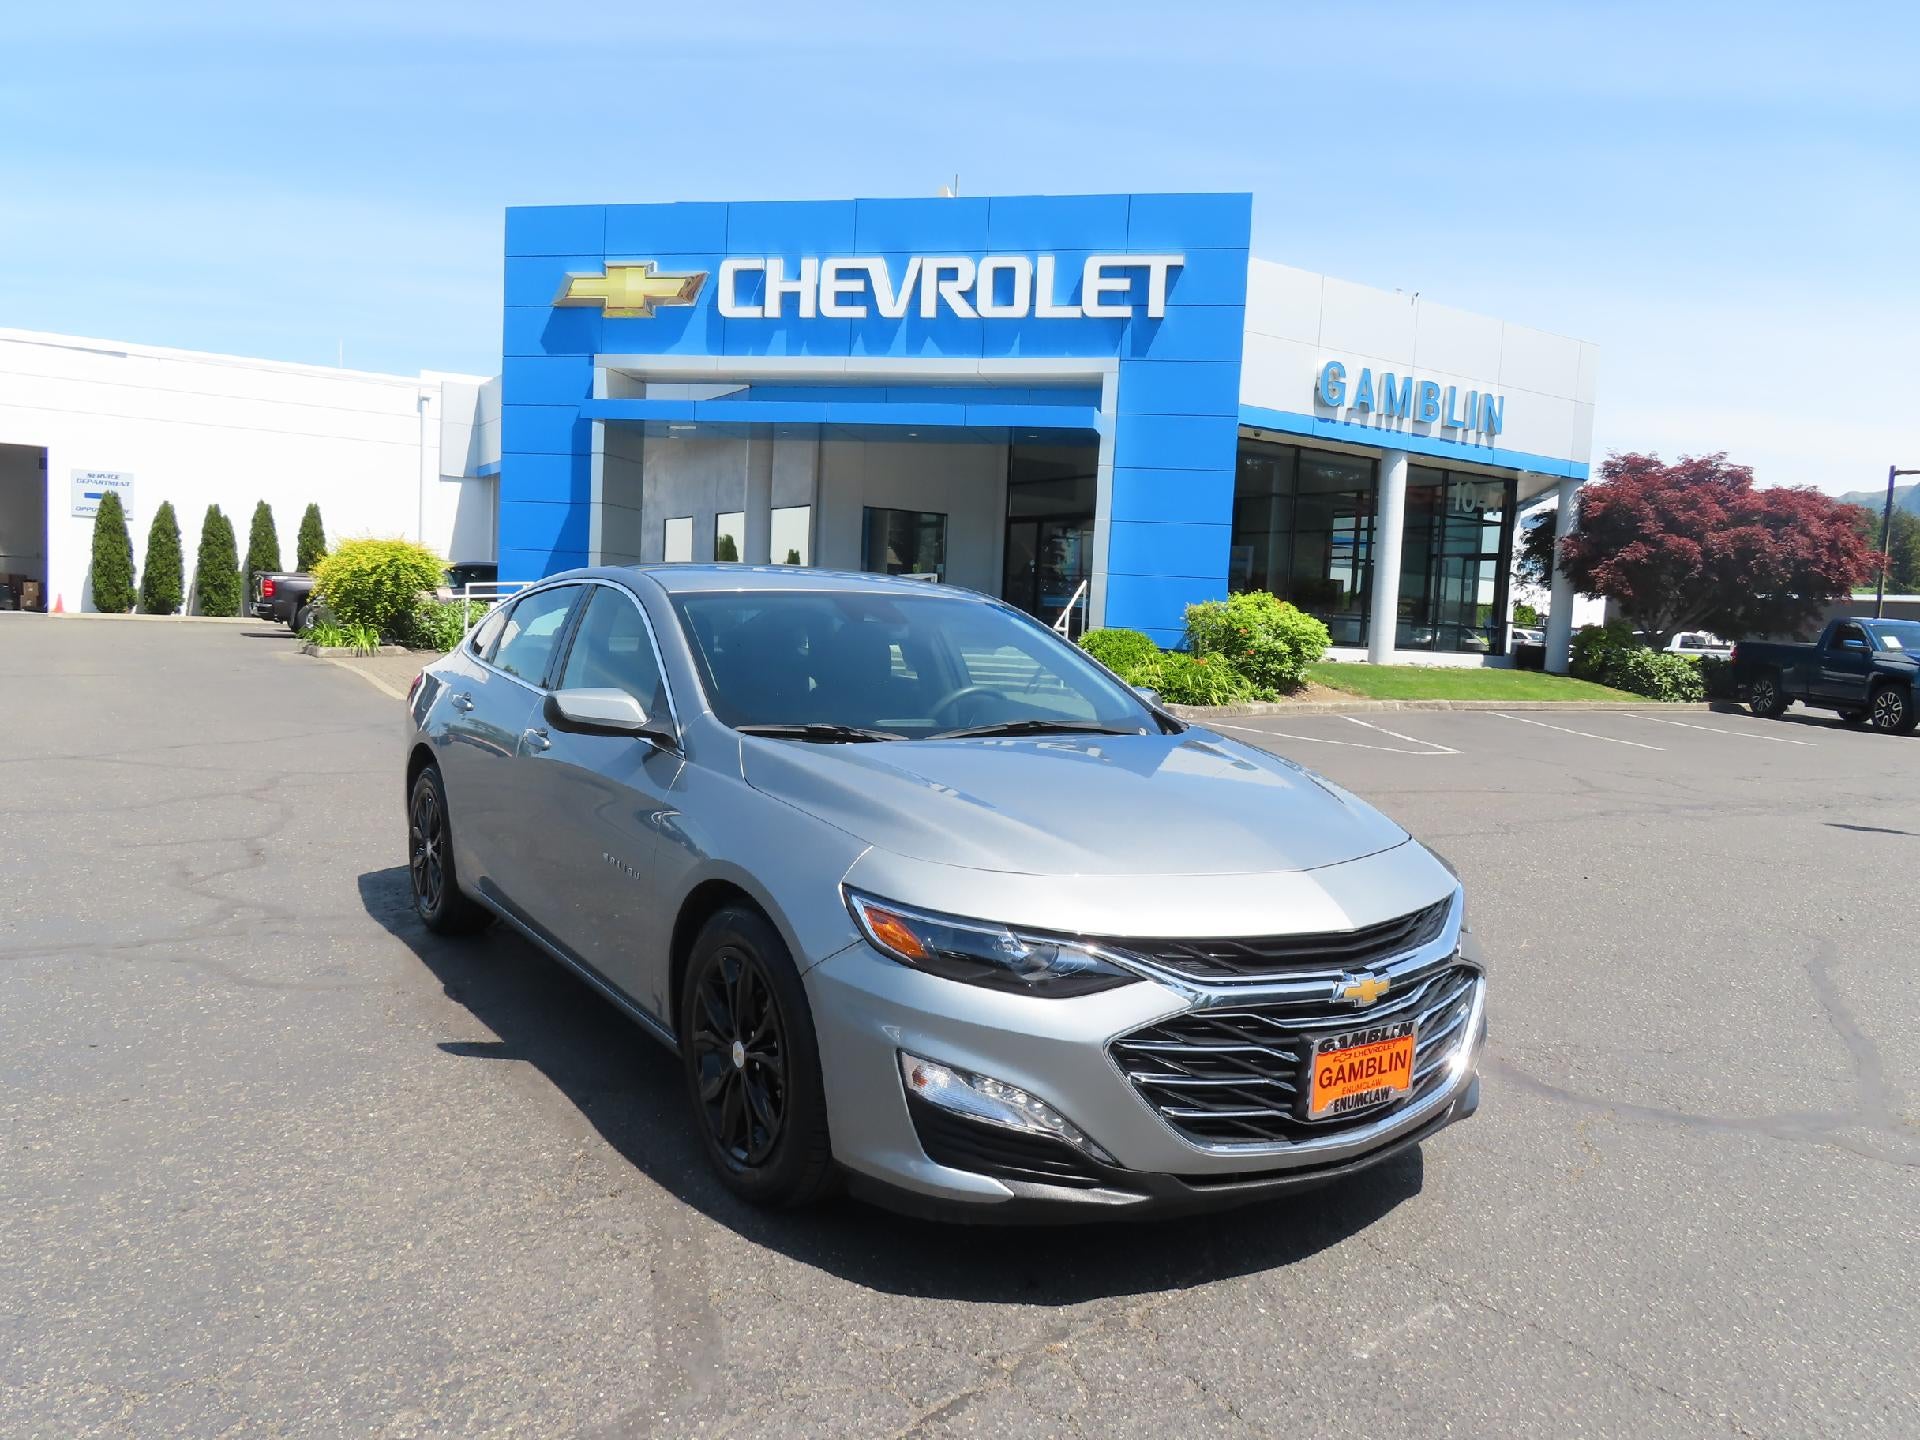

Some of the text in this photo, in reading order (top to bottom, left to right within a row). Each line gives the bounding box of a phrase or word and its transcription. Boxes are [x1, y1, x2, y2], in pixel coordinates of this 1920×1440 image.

[717, 254, 1185, 319] CHEVROLET
[1318, 360, 1505, 436] GAMBLIN
[1318, 1022, 1414, 1053] GAMBLIN
[1319, 1049, 1408, 1090] GAMBLIN
[1342, 1078, 1382, 1096] ENUMCLAW
[1334, 1087, 1390, 1113] ENUMCLAW
